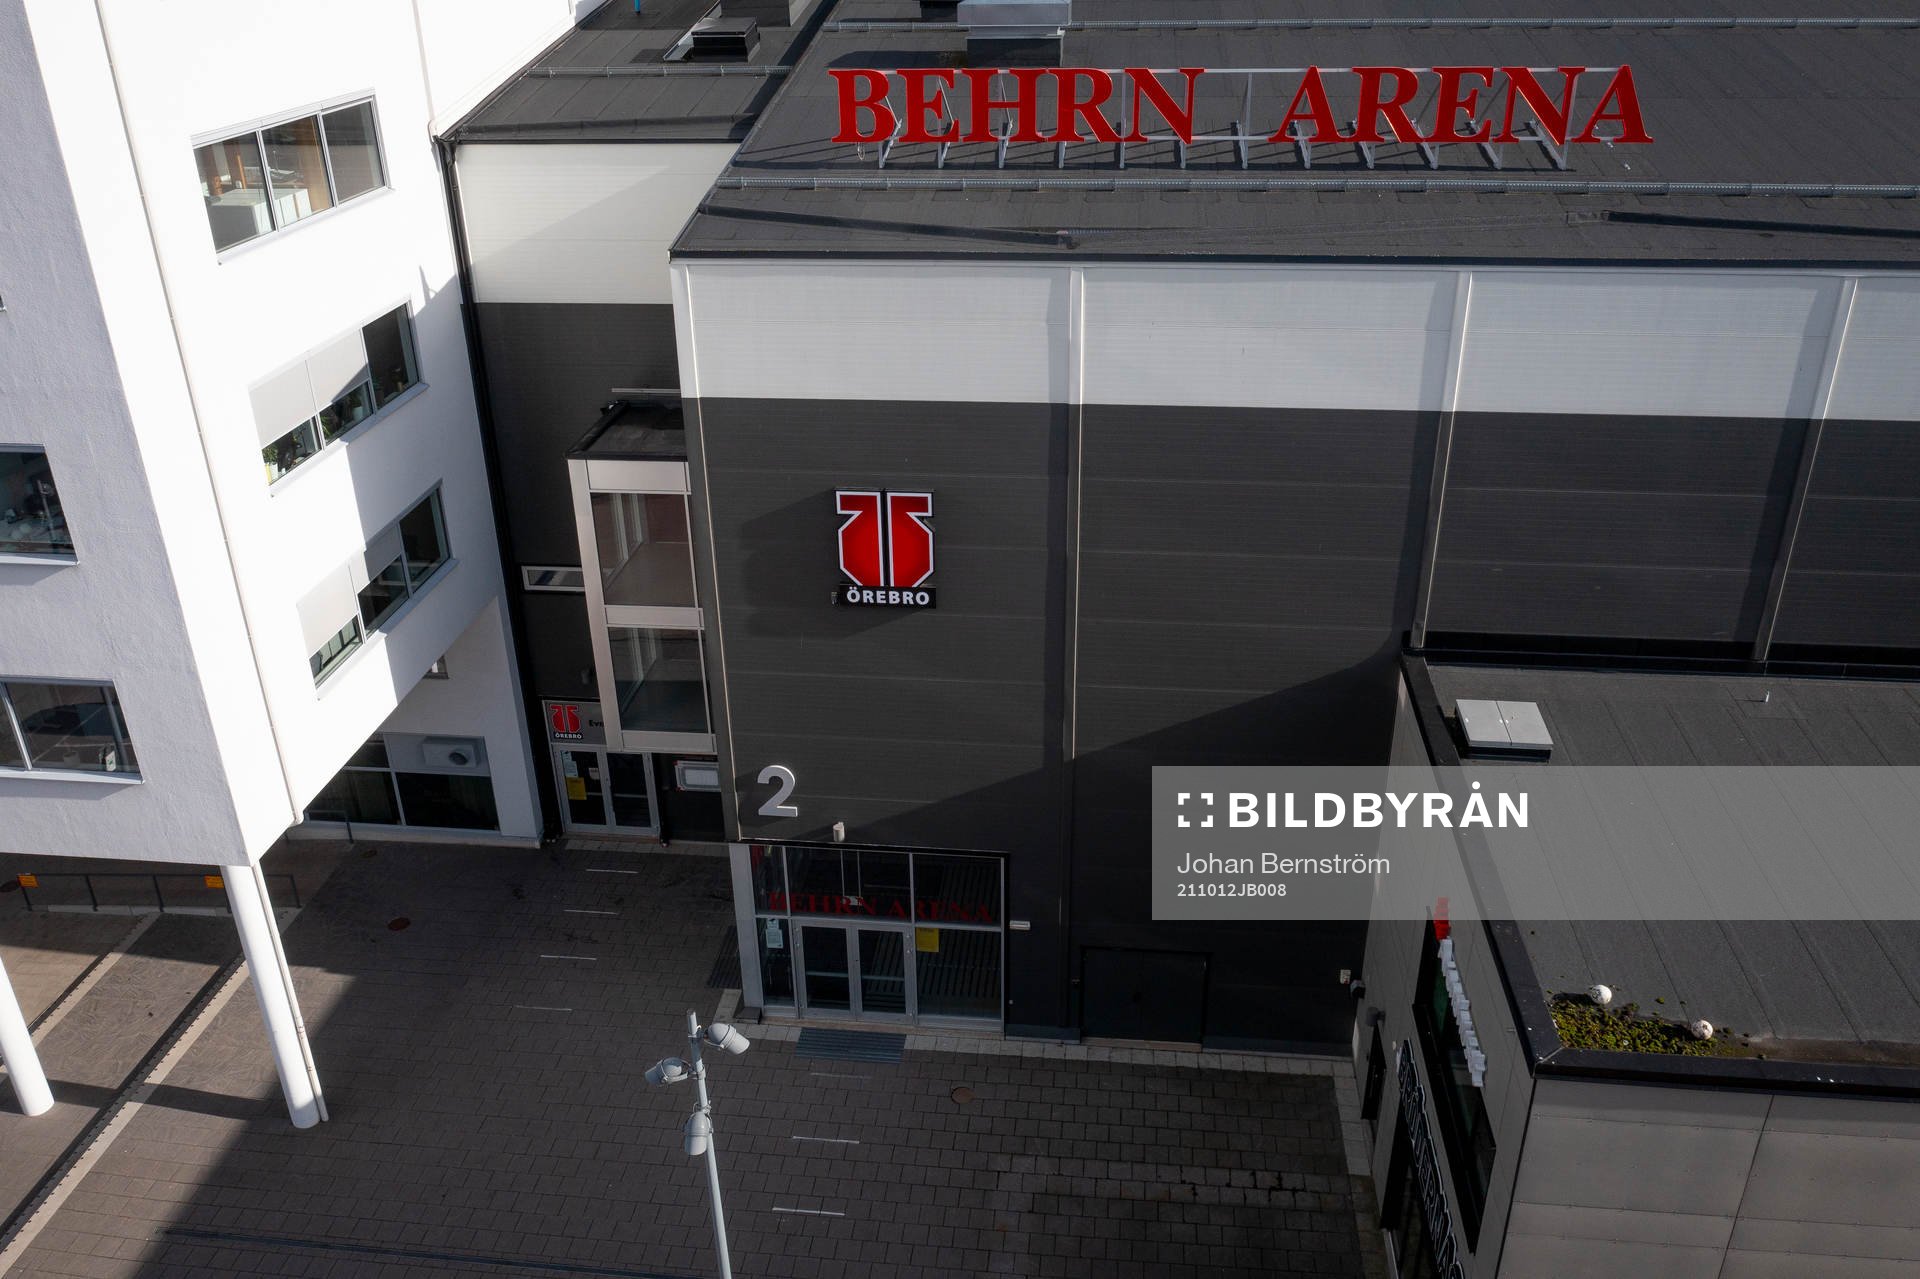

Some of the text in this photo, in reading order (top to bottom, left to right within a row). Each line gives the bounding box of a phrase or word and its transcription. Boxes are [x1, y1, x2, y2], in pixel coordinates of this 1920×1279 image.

[828, 64, 1654, 145] BEHRN ARENA
[846, 586, 930, 605] ÖREBRO
[757, 765, 798, 817] 2
[1398, 1037, 1465, 1279] BRÖDERNA
